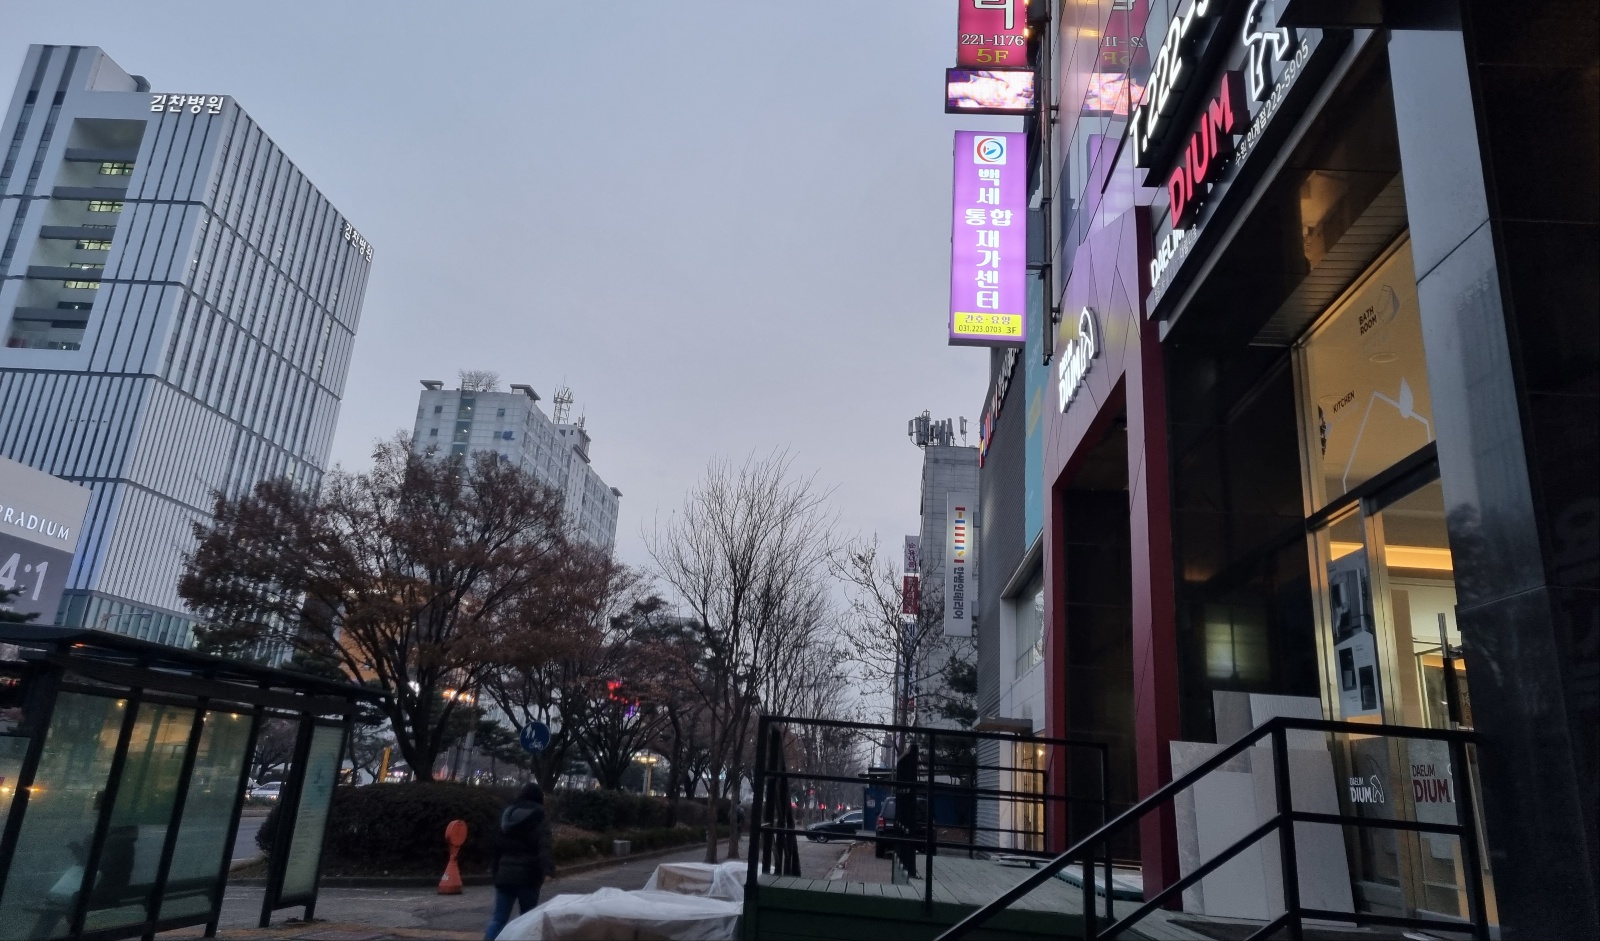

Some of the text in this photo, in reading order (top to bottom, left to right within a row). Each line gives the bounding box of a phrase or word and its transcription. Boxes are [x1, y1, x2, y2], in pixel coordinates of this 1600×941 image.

[961, 33, 1025, 46] 221-1176
[976, 48, 1009, 63] 5F
[150, 94, 224, 114] 김찬병원
[1168, 71, 1234, 229] DIUM
[344, 222, 373, 263] 김찬병원
[1358, 305, 1375, 326] BATH
[1360, 314, 1378, 336] ROOM
[958, 324, 1018, 335] 031.223.0703 3F
[1058, 345, 1081, 414] DIUM
[1333, 389, 1355, 414] KITCHEN
[1411, 764, 1436, 777] DAELIM
[1350, 787, 1373, 803] DIUM
[1411, 778, 1452, 803] DIUM
